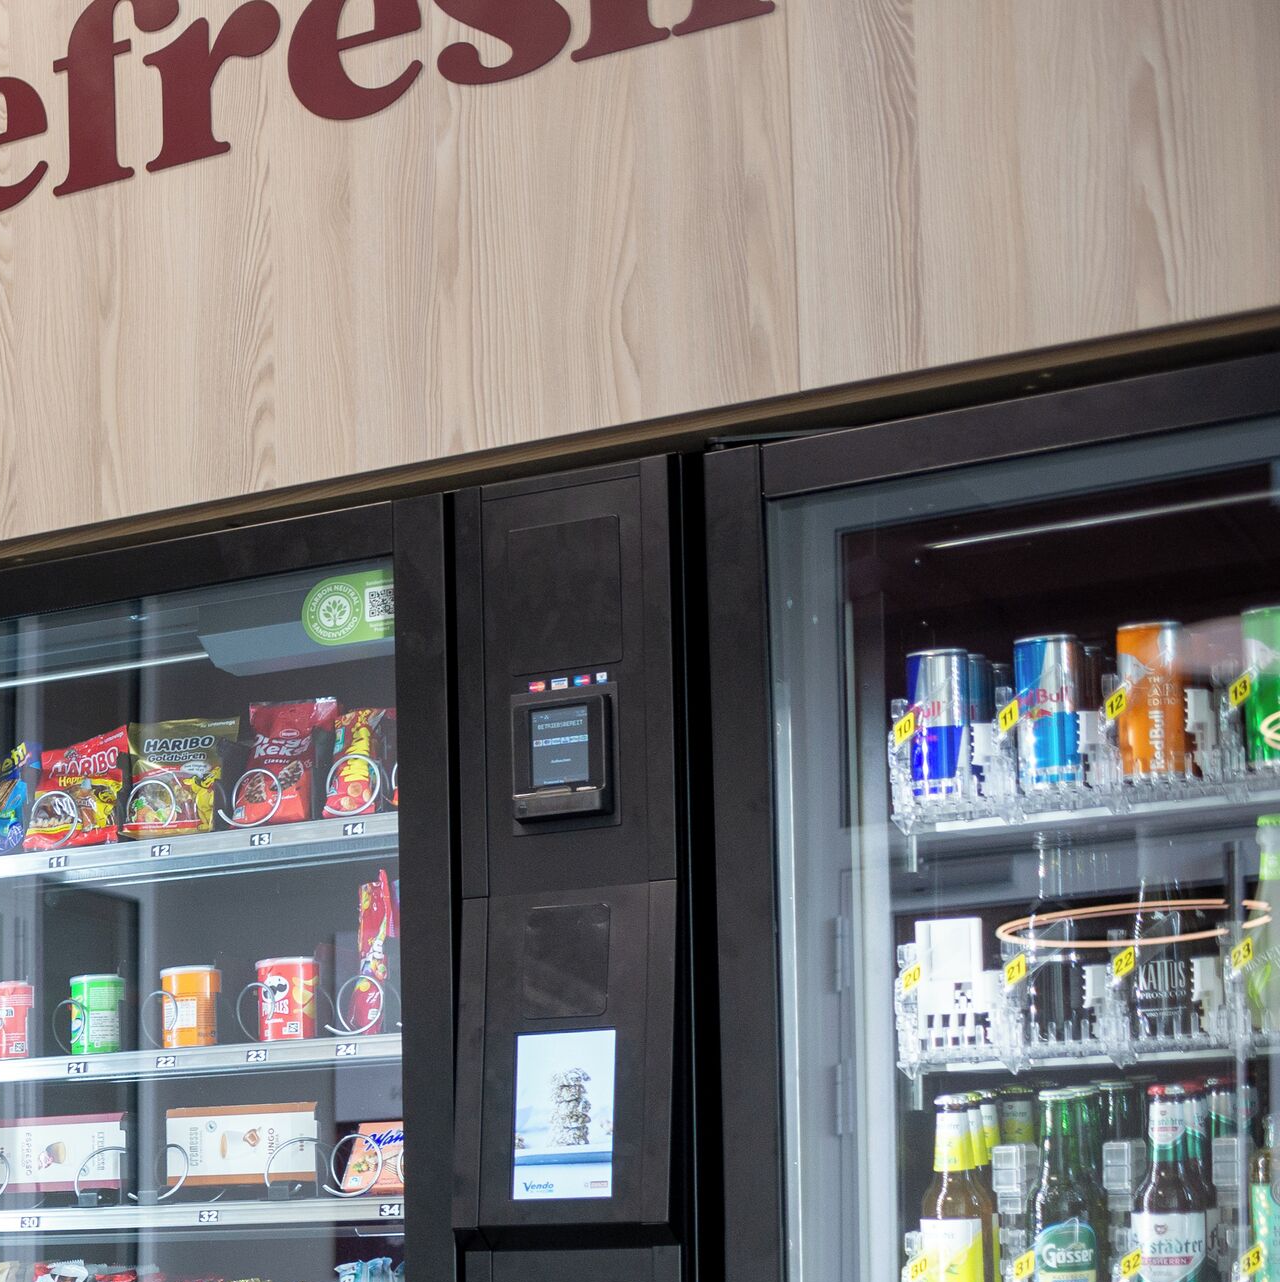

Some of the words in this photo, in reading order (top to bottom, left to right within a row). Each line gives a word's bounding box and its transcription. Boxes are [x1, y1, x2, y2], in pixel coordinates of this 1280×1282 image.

[1231, 680, 1249, 699] 13
[1107, 694, 1124, 715] 12
[1000, 708, 1014, 726] 11
[897, 719, 912, 738] 10
[144, 735, 216, 753] HARIBO
[147, 750, 208, 763] Goldbären
[344, 824, 364, 835] 14
[251, 834, 270, 846] 13
[151, 845, 170, 856] 12
[50, 857, 67, 867] 11
[1113, 953, 1133, 972] 22
[1232, 943, 1252, 964] 23
[903, 971, 922, 989] 20
[1006, 961, 1023, 981] 21
[1140, 960, 1187, 990] KATTUS
[247, 1050, 266, 1062] 23
[337, 1044, 356, 1056] 24
[68, 1063, 85, 1073] 21
[157, 1057, 176, 1067] 22
[267, 1127, 275, 1156] UNGO
[523, 1180, 555, 1192] Vendo
[199, 1210, 218, 1222] 32
[380, 1204, 400, 1216] 34
[20, 1217, 39, 1228] 30
[1042, 1242, 1094, 1268] Gösser
[1243, 1251, 1262, 1272] 33
[910, 1258, 928, 1279] 30
[1014, 1259, 1032, 1278] 31
[1122, 1256, 1141, 1275] 32
